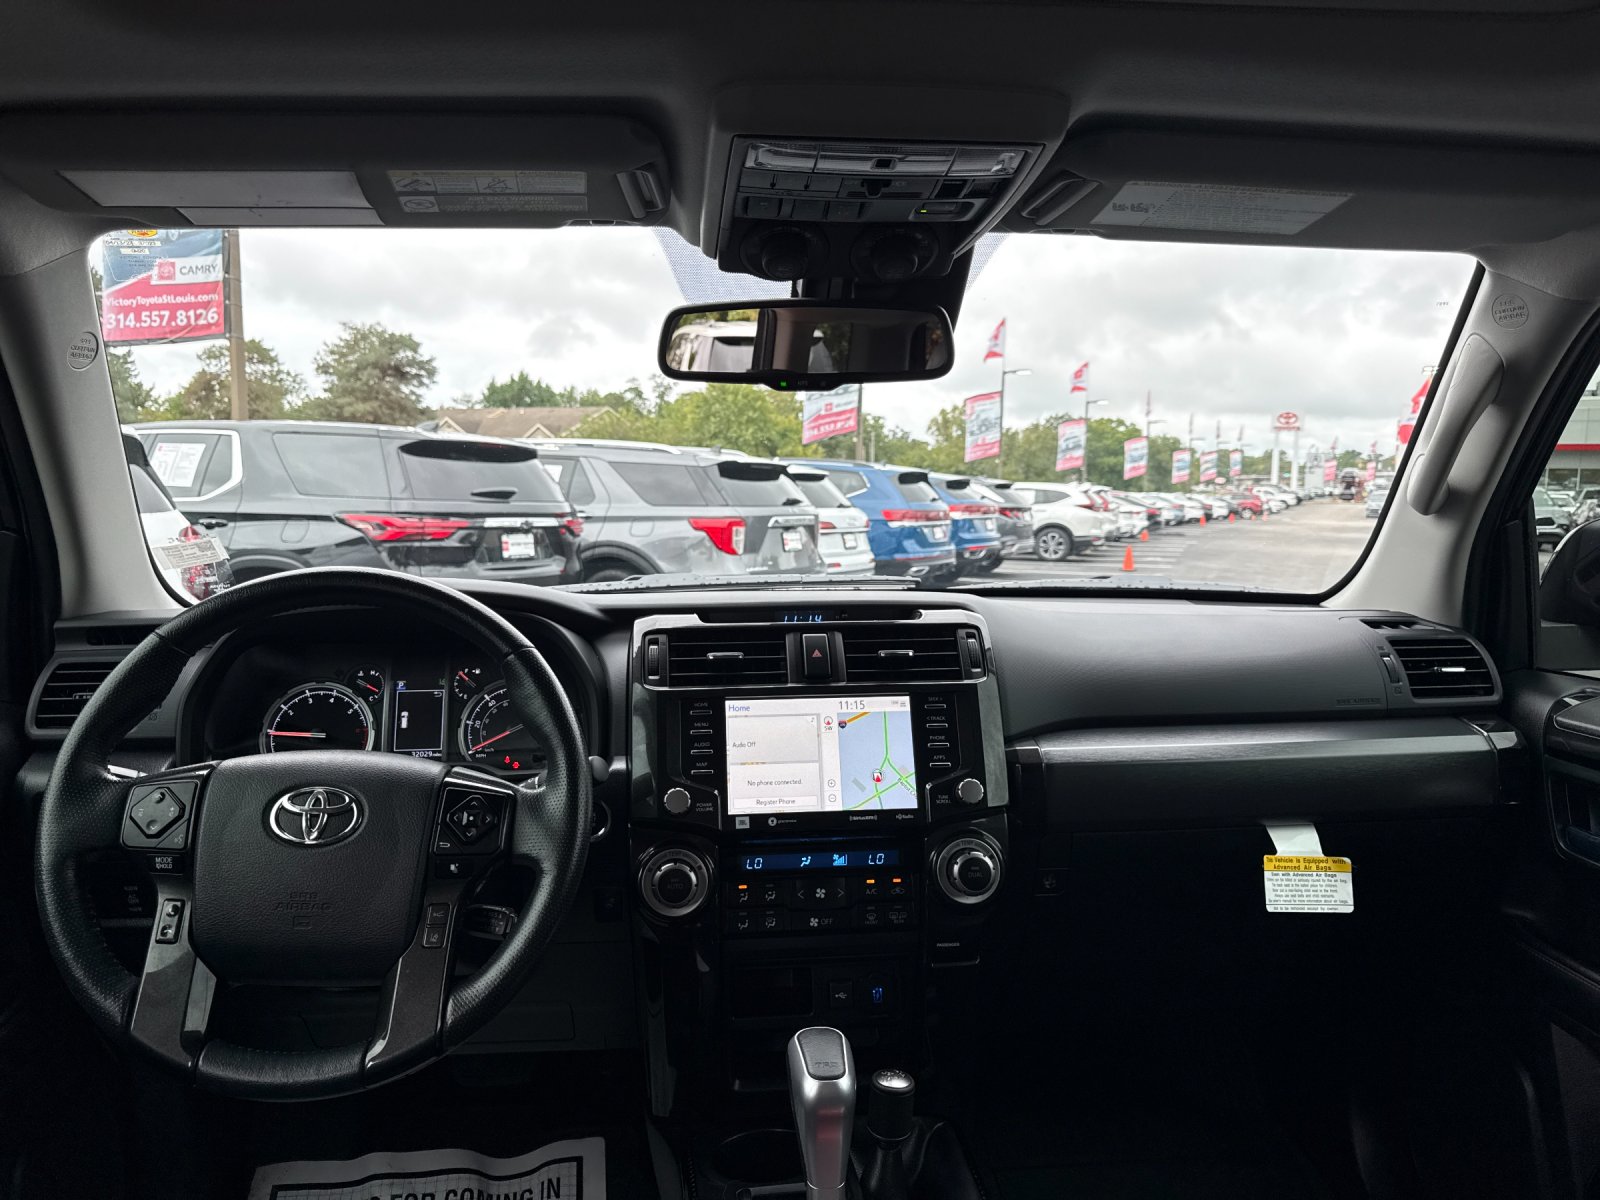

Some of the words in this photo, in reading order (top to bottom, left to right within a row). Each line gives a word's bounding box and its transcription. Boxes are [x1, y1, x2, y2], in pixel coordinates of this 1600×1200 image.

[179, 263, 218, 276] CAMRY
[105, 308, 219, 330] 314.557.8126
[728, 704, 751, 712] Home
[839, 700, 866, 710] 11:15
[746, 858, 762, 869] LO
[868, 853, 884, 865] LO
[445, 1187, 533, 1200] COMG
[540, 1176, 562, 1200] IN
